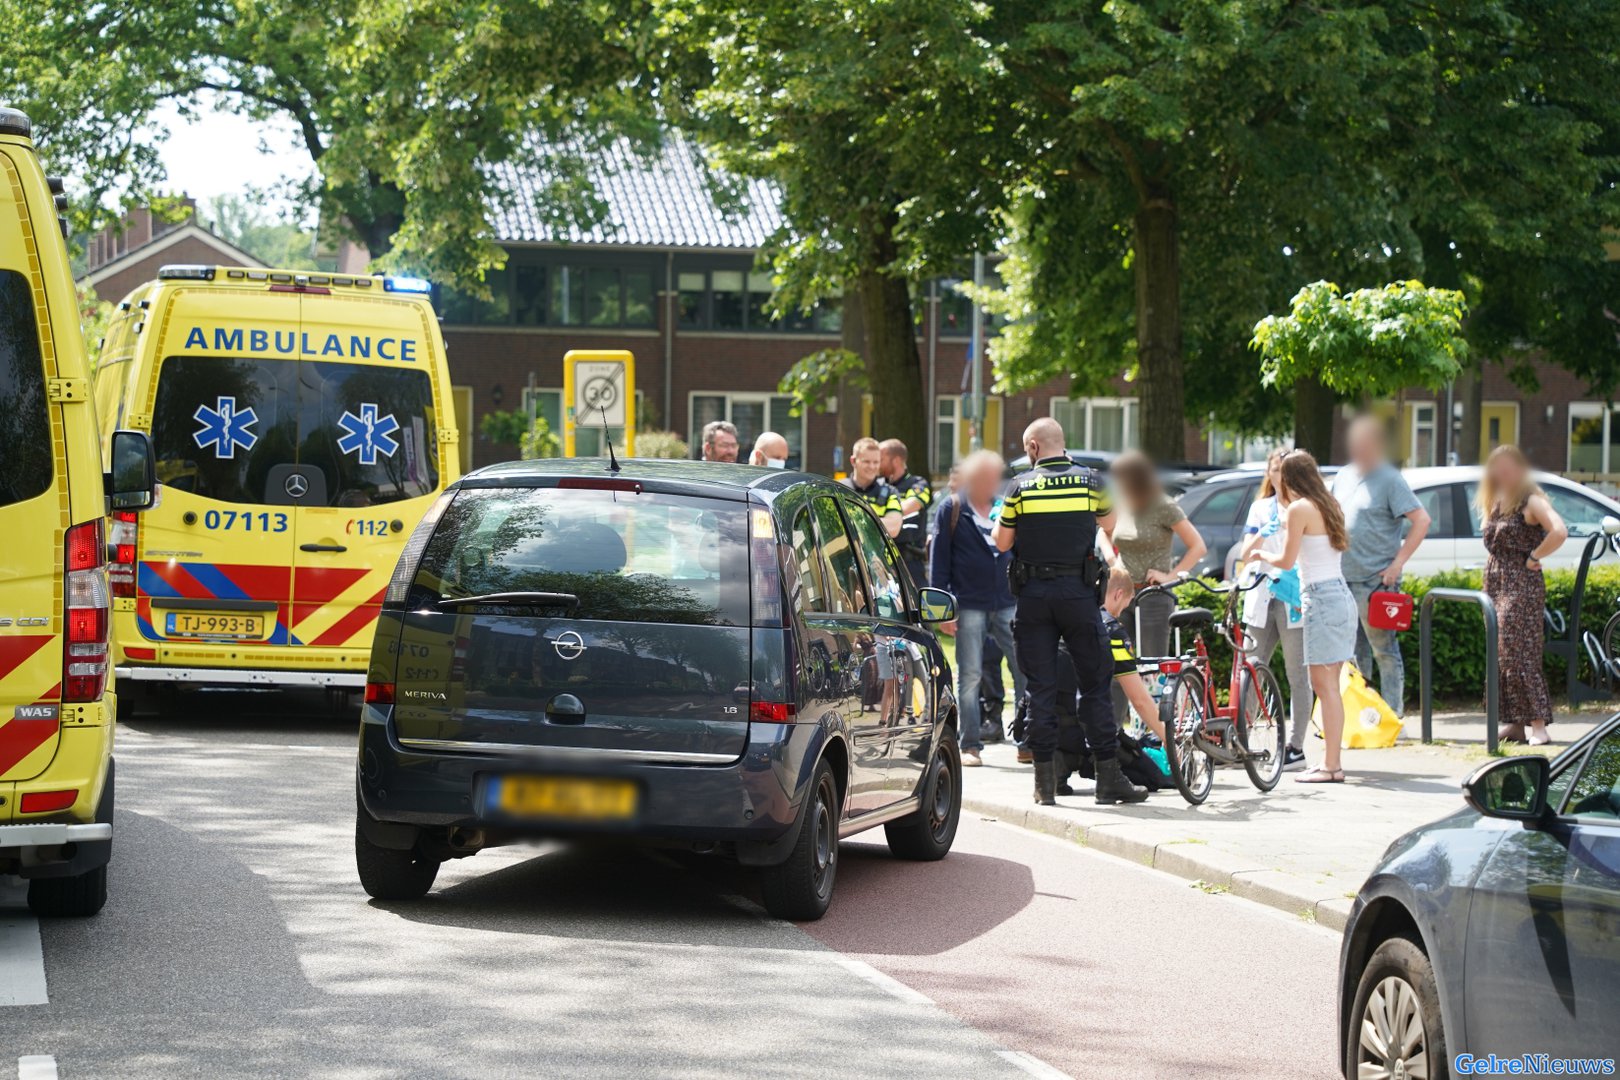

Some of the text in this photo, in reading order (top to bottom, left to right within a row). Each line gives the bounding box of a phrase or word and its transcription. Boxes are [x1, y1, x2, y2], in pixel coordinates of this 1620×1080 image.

[184, 326, 416, 362] AMBULANCE
[589, 386, 612, 401] 30
[1029, 474, 1081, 490] POLITIE
[204, 510, 288, 533] 07113
[182, 616, 255, 633] TJ-993-B
[404, 690, 447, 700] MERIVA
[20, 707, 52, 717] WAS
